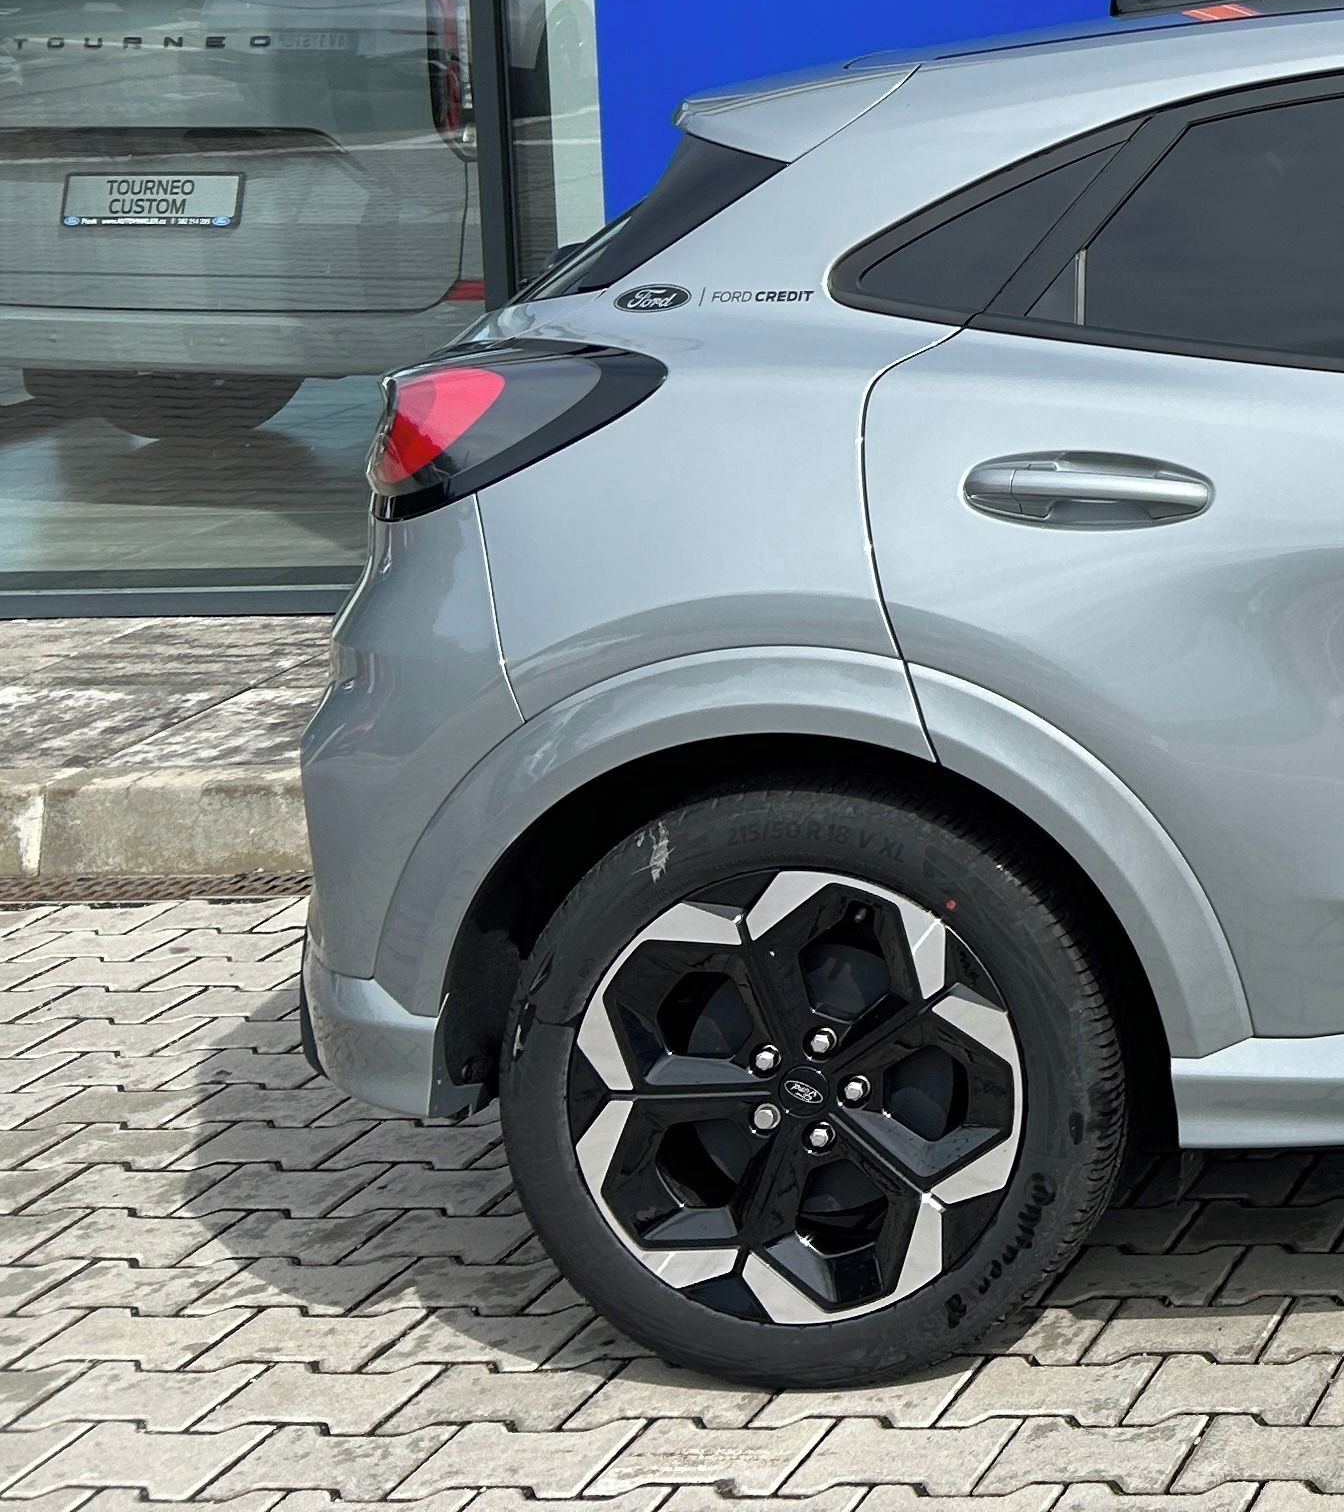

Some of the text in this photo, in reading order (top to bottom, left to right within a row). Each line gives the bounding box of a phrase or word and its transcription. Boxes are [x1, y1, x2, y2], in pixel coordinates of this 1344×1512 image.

[12, 35, 273, 50] TOURNEO
[106, 179, 195, 196] TOURNEO
[108, 198, 187, 215] CUSTOM
[627, 289, 815, 309] Ford FORD CREDIT
[726, 820, 801, 847] 215/50
